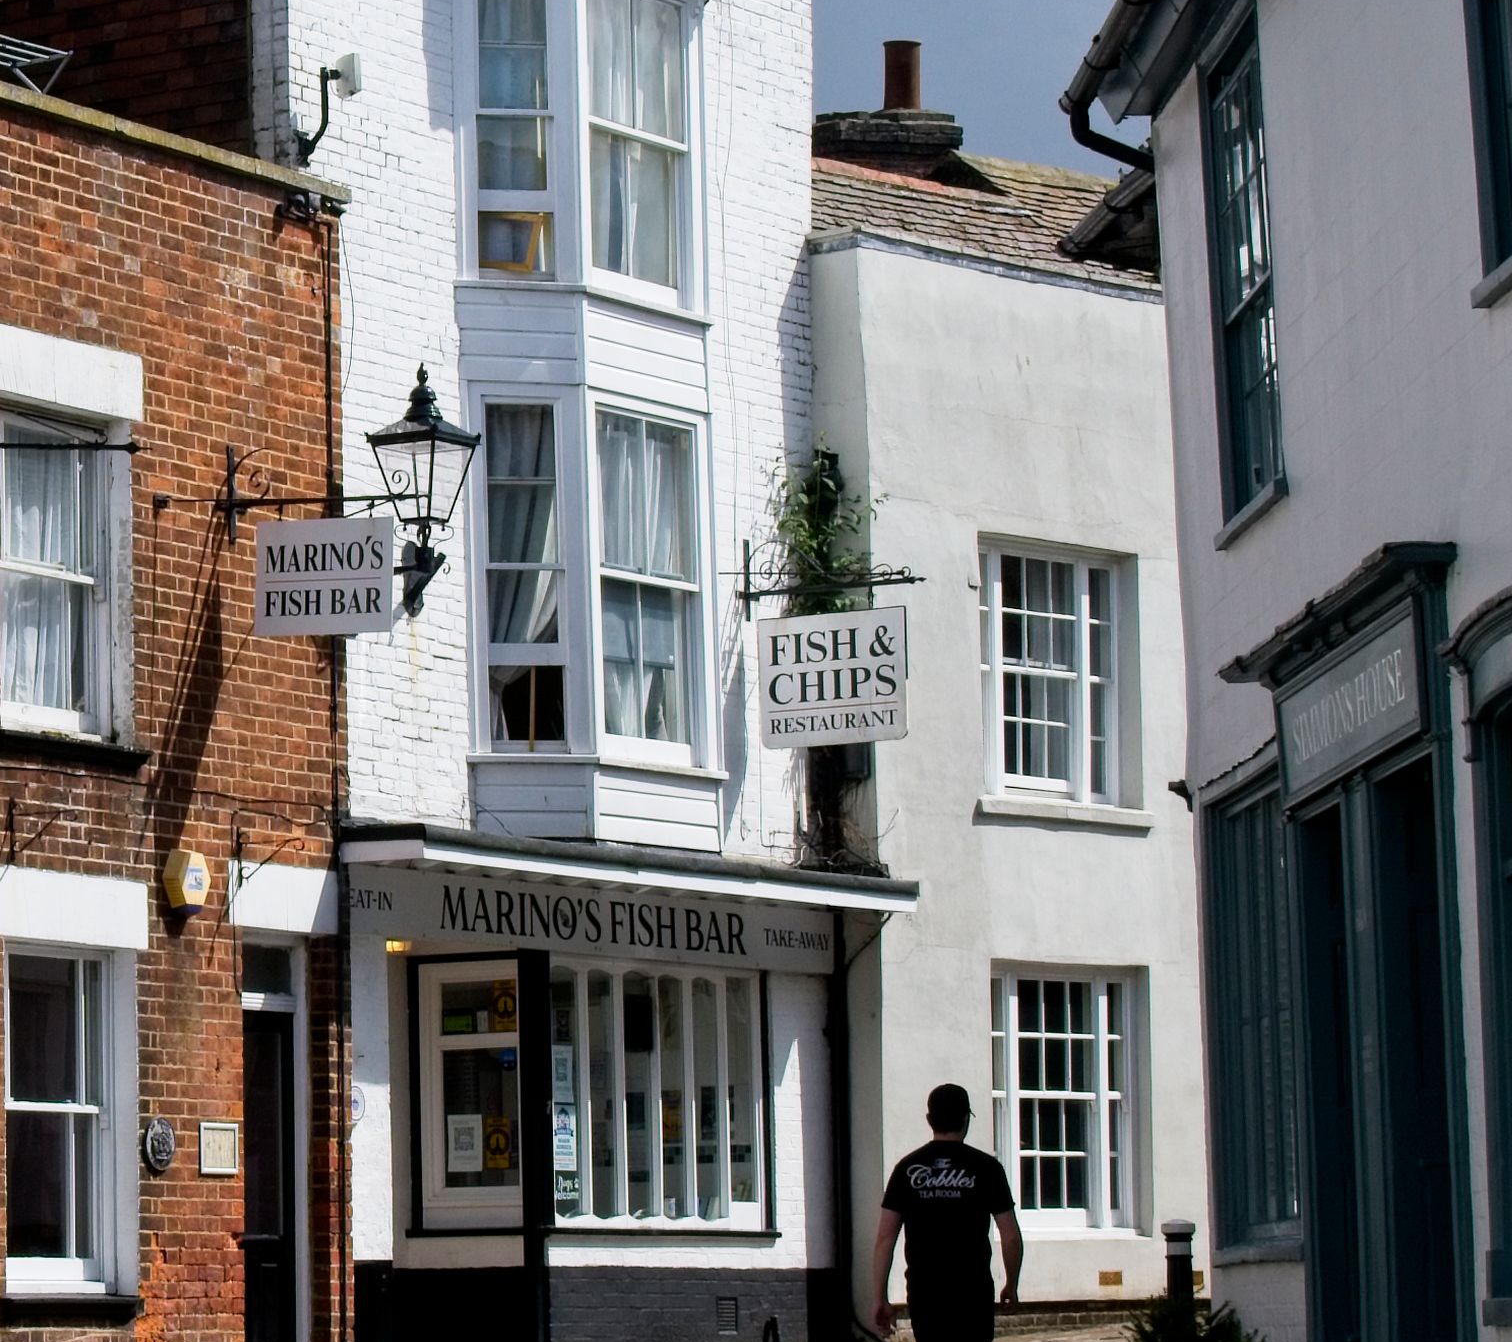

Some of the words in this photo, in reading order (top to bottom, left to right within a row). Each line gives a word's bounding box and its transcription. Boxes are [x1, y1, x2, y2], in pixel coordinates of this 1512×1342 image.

[264, 535, 384, 574] MARINO'S
[264, 588, 322, 617] FISH
[330, 587, 382, 615] BAR
[768, 626, 860, 667] FISH
[868, 625, 896, 658] &
[768, 663, 897, 706] CHIPS
[1354, 648, 1406, 728] HOUSE
[769, 709, 898, 735] RESTAURANT
[348, 887, 393, 911] EAT-IN
[439, 884, 602, 944] MARINO'S
[609, 900, 677, 950] FISH
[684, 908, 748, 956] BAR
[763, 927, 831, 952] TAKE-AWAY
[906, 1164, 976, 1189] Cobbles
[918, 1190, 934, 1199] TEA
[935, 1190, 961, 1198] ROOM
